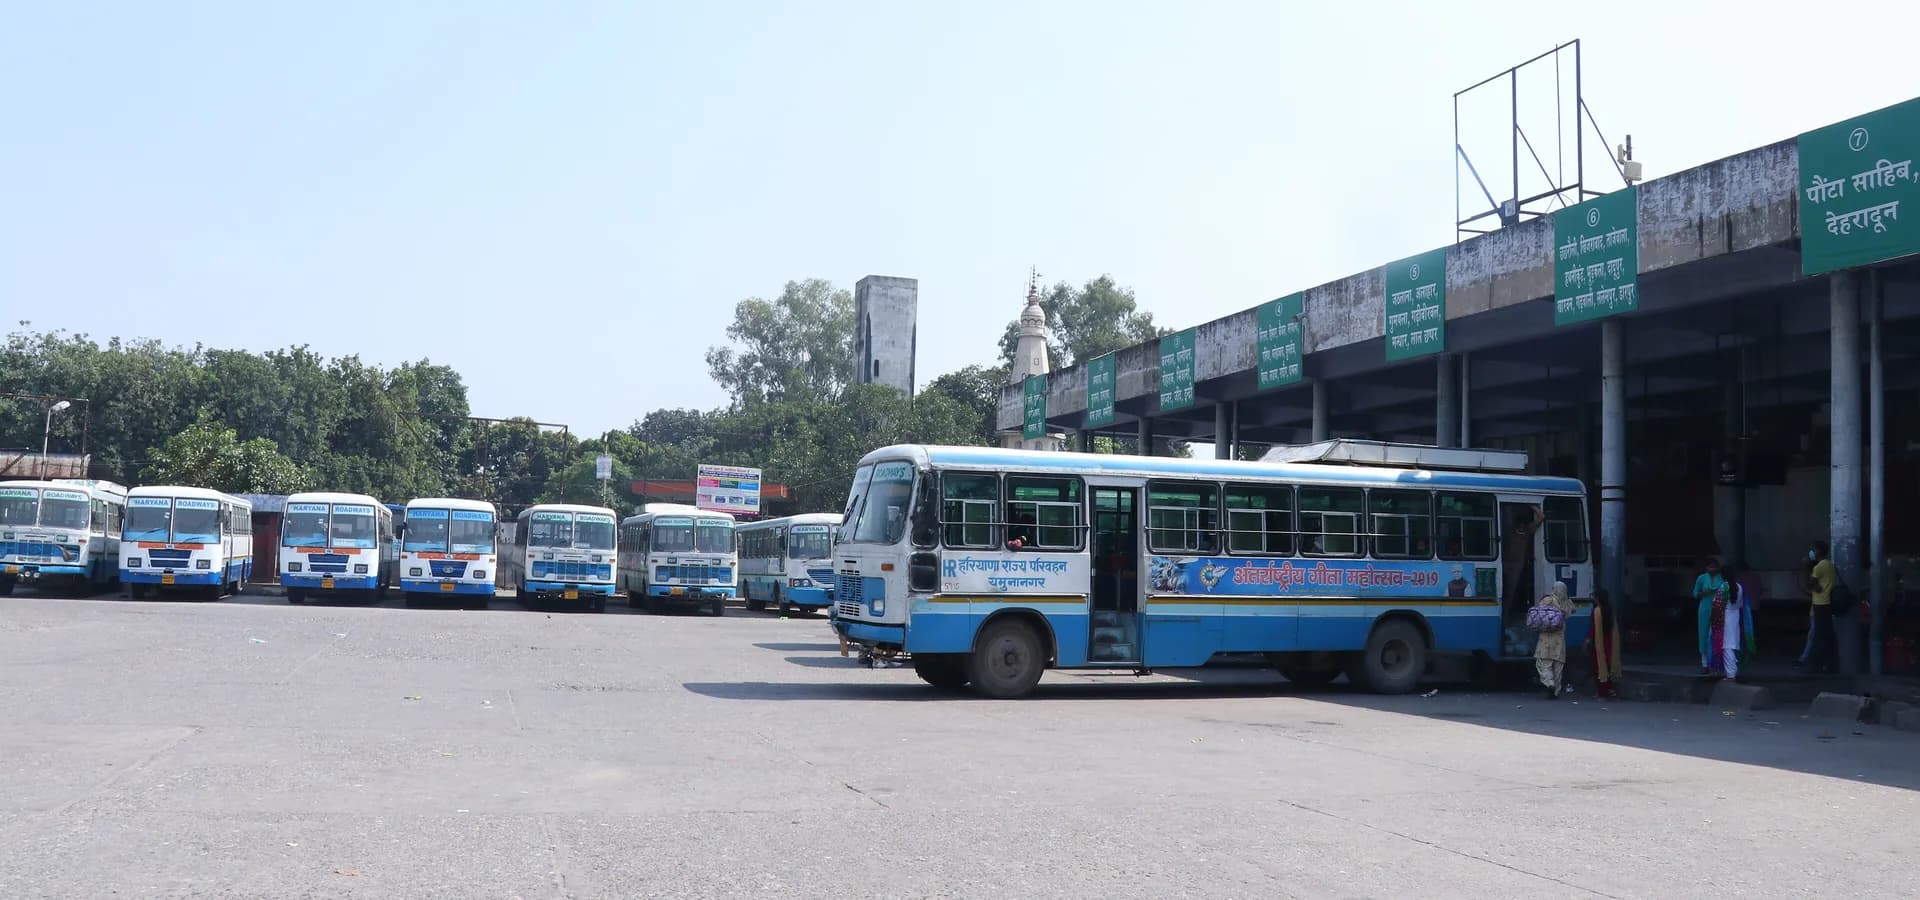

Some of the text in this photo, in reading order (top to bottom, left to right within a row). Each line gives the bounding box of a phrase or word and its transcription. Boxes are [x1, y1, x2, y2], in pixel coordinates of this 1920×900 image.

[1805, 159, 1919, 203] पौंटा साहिब,
[1826, 200, 1899, 235] देहरादून
[1411, 331, 1422, 344] लाल
[943, 560, 957, 577] HR
[958, 556, 1068, 575] हरियाणा राज्य परिवहन
[988, 577, 1046, 592] यमुनानगर
[1232, 560, 1306, 592] अंतर्राष्ट्रीय
[1308, 561, 1344, 585] गीता
